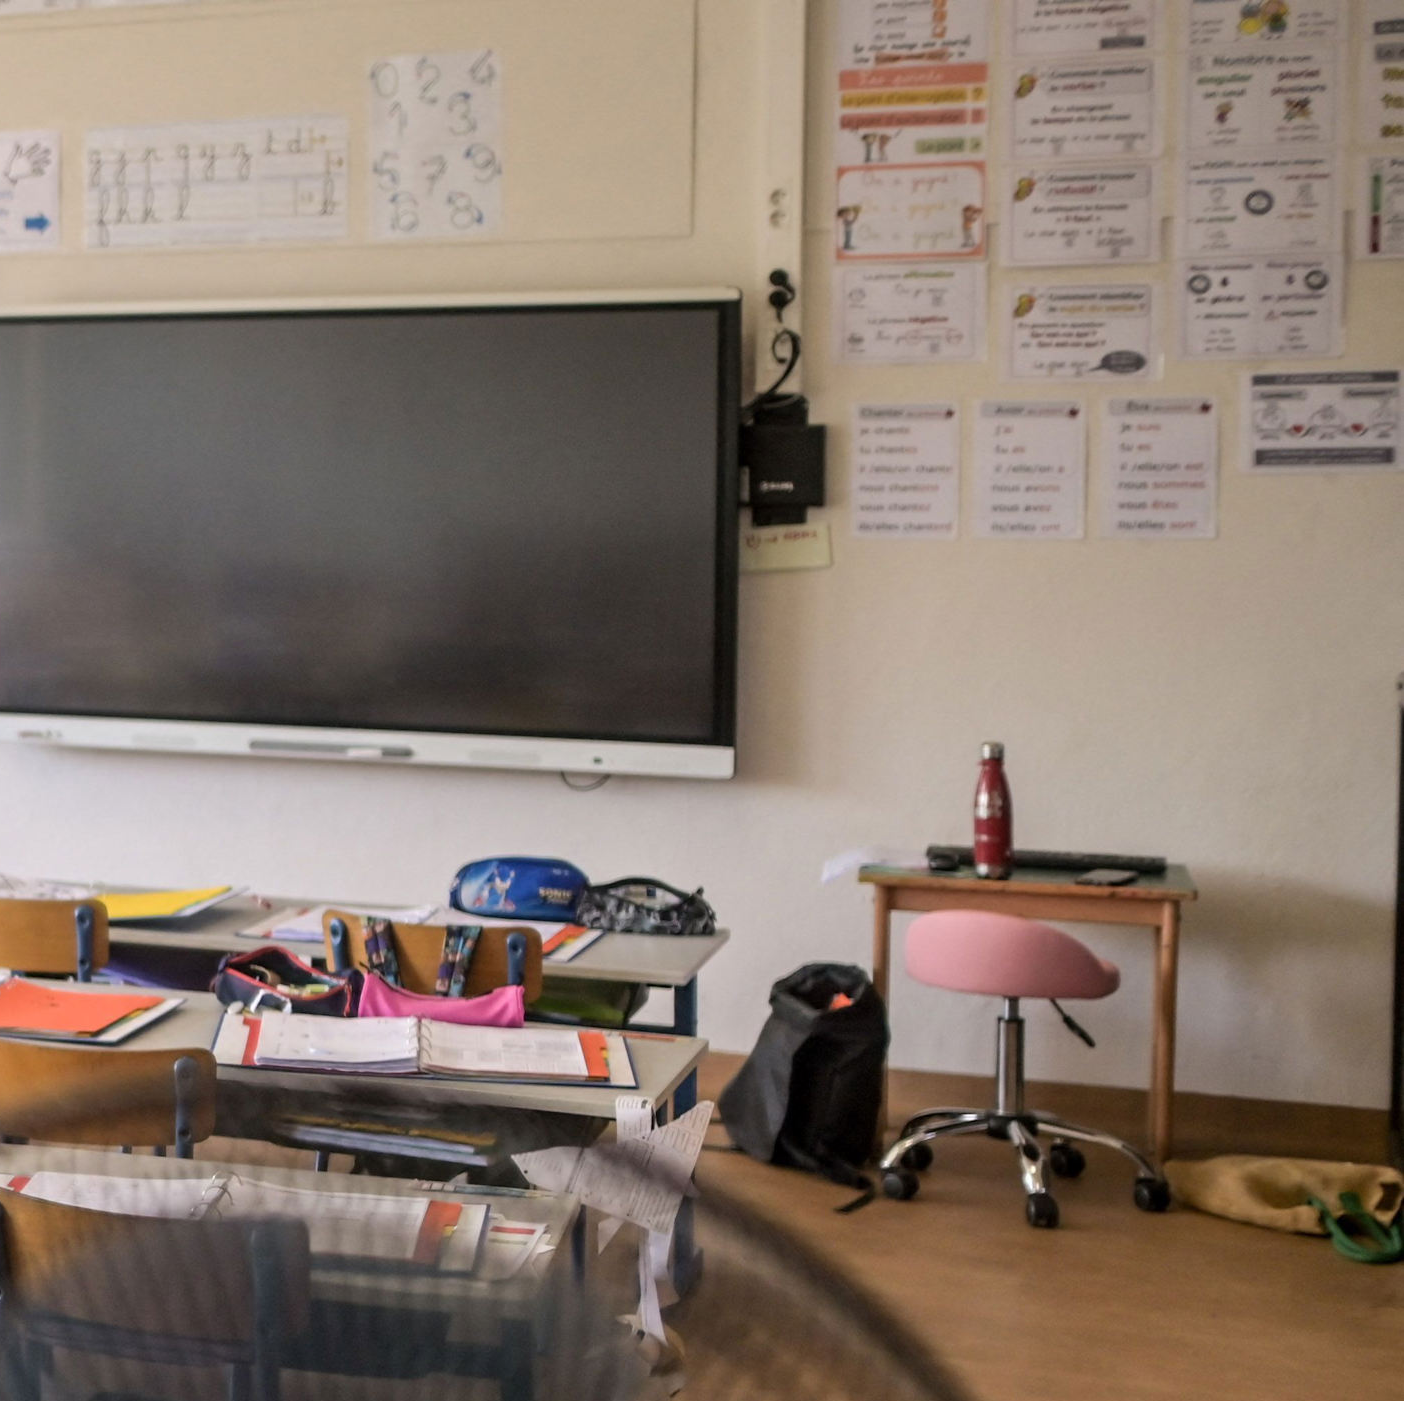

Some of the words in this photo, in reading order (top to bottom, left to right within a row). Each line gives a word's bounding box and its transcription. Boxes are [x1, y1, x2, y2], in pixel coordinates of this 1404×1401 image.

[417, 58, 440, 104] 2
[860, 407, 903, 418] Chanter
[888, 482, 939, 493] chantons
[1118, 480, 1148, 490] nous
[1150, 480, 1205, 490] sommes
[1118, 500, 1147, 510] vous
[903, 521, 952, 533] chantent
[539, 887, 573, 899] SONIC
